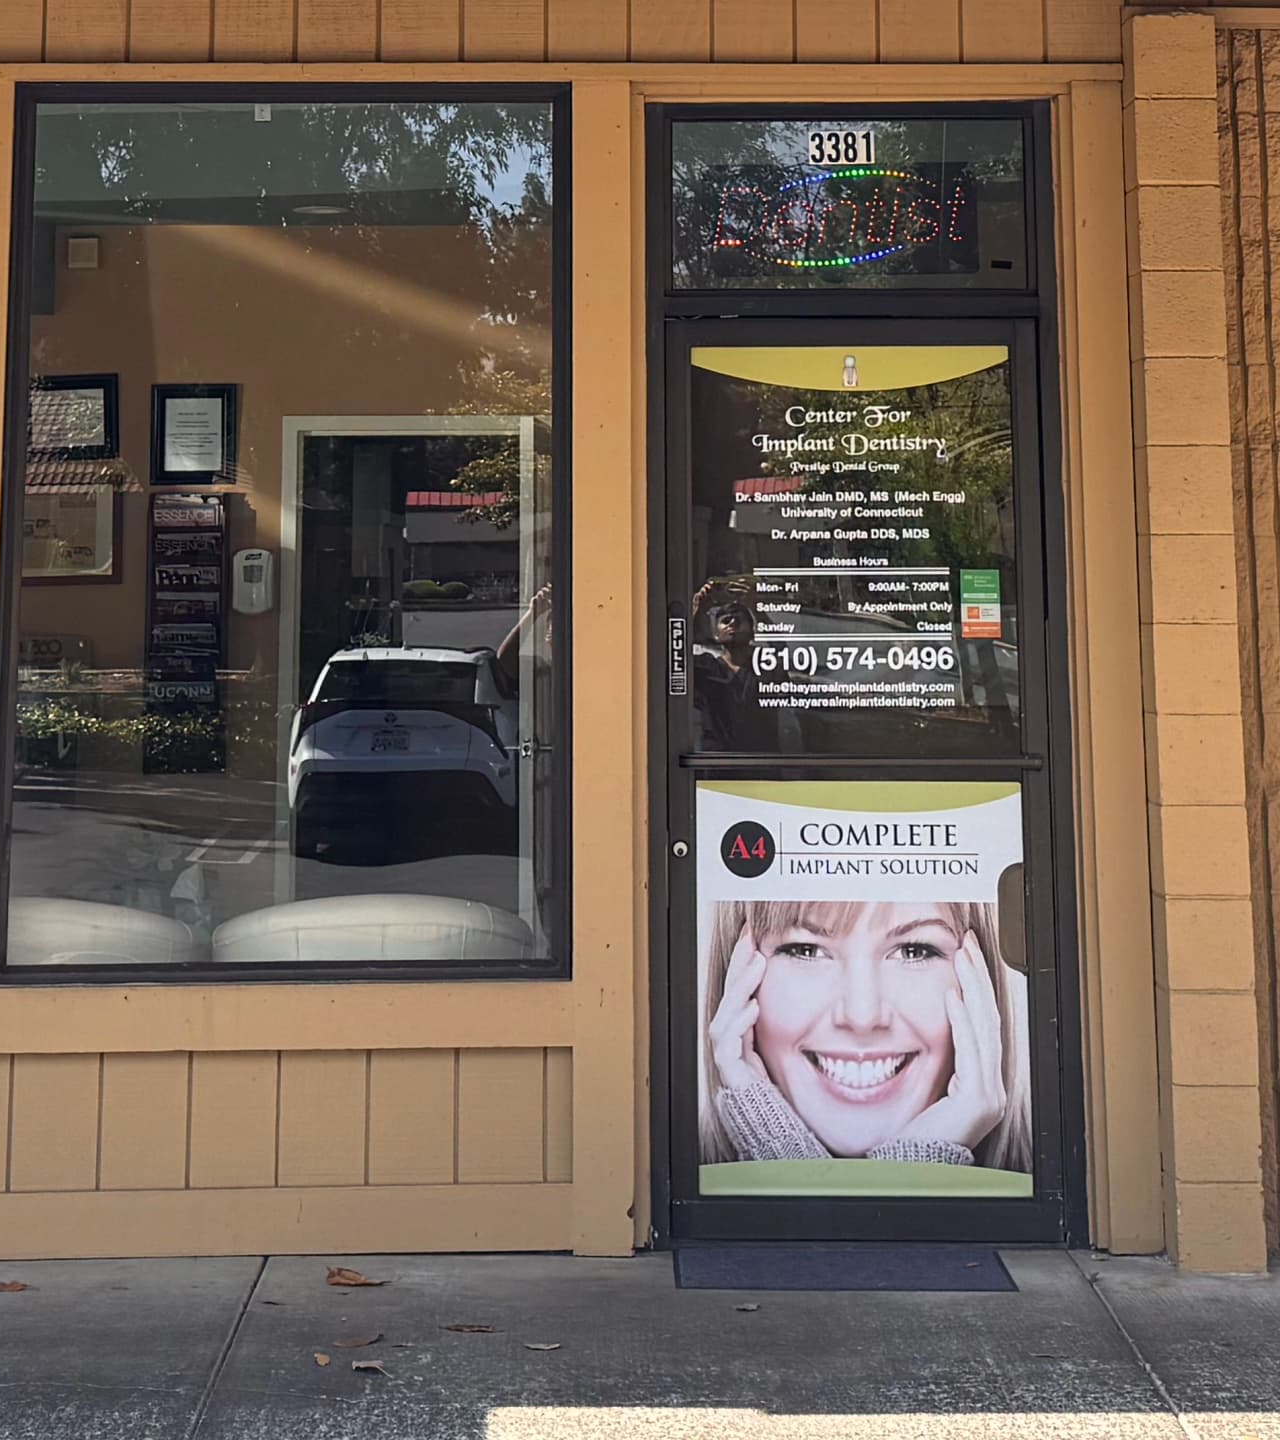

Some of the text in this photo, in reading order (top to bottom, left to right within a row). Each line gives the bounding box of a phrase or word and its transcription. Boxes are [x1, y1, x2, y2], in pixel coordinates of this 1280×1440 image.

[810, 132, 872, 163] 3381
[714, 183, 967, 250] Dentist
[785, 405, 911, 428] Center For
[752, 433, 949, 461] Implant Dentistry
[790, 461, 901, 474] Prestige Dental Group
[735, 491, 966, 505] Dr. Sambhav Jain DMD, MS (Mech Engg)
[781, 506, 924, 520] University of Connecticut
[771, 528, 930, 542] Dr. Arpana Gupta DDS, MDS
[813, 556, 889, 567] Business Hours
[785, 582, 799, 592] Fri
[912, 582, 950, 592] 7:00PM
[756, 601, 953, 614] Saturday By Appointment Only
[757, 621, 795, 633] Sunday
[916, 621, 953, 631] Closed
[673, 629, 683, 672] PULL
[752, 646, 954, 676] (510) 574-0496
[758, 695, 956, 709] www.bayareaimplantdentistry.com
[728, 823, 958, 860] A4 COMPLETE
[789, 859, 979, 875] IMPLANT SOLUTION
